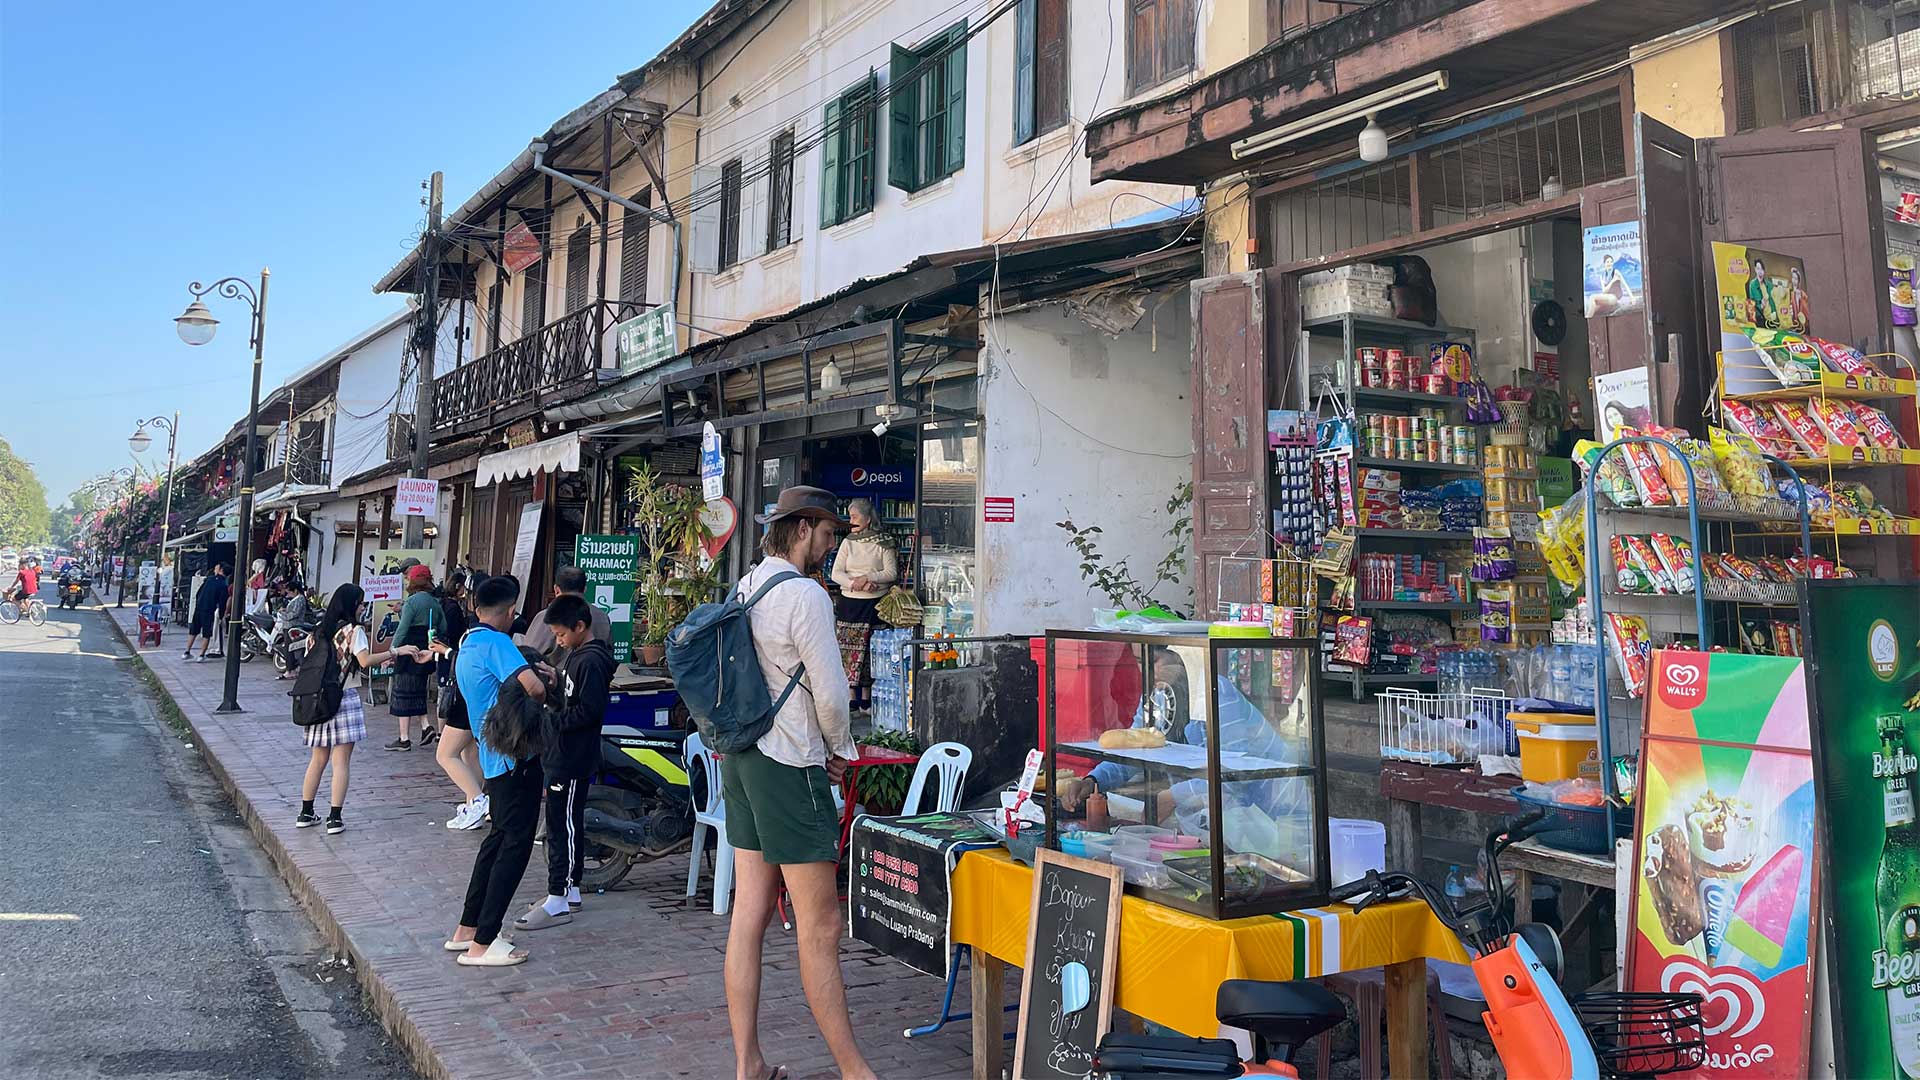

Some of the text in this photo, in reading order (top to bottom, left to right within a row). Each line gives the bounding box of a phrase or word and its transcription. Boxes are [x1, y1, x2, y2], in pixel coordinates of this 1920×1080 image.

[1842, 360, 1859, 373] 20
[1600, 383, 1623, 394] Dove
[1797, 423, 1812, 434] 20
[1829, 419, 1844, 431] 20
[1869, 423, 1887, 437] 20
[869, 472, 903, 486] pepsi
[400, 481, 437, 493] LAUNDRY
[580, 558, 633, 569] PHARMACY
[1462, 610, 1480, 620] Bee
[1623, 646, 1637, 658] 20
[1666, 686, 1696, 697] WALL'S
[1886, 778, 1907, 790] GREEN
[1045, 872, 1096, 921] Bonjour
[890, 918, 934, 949] Luang Prabang
